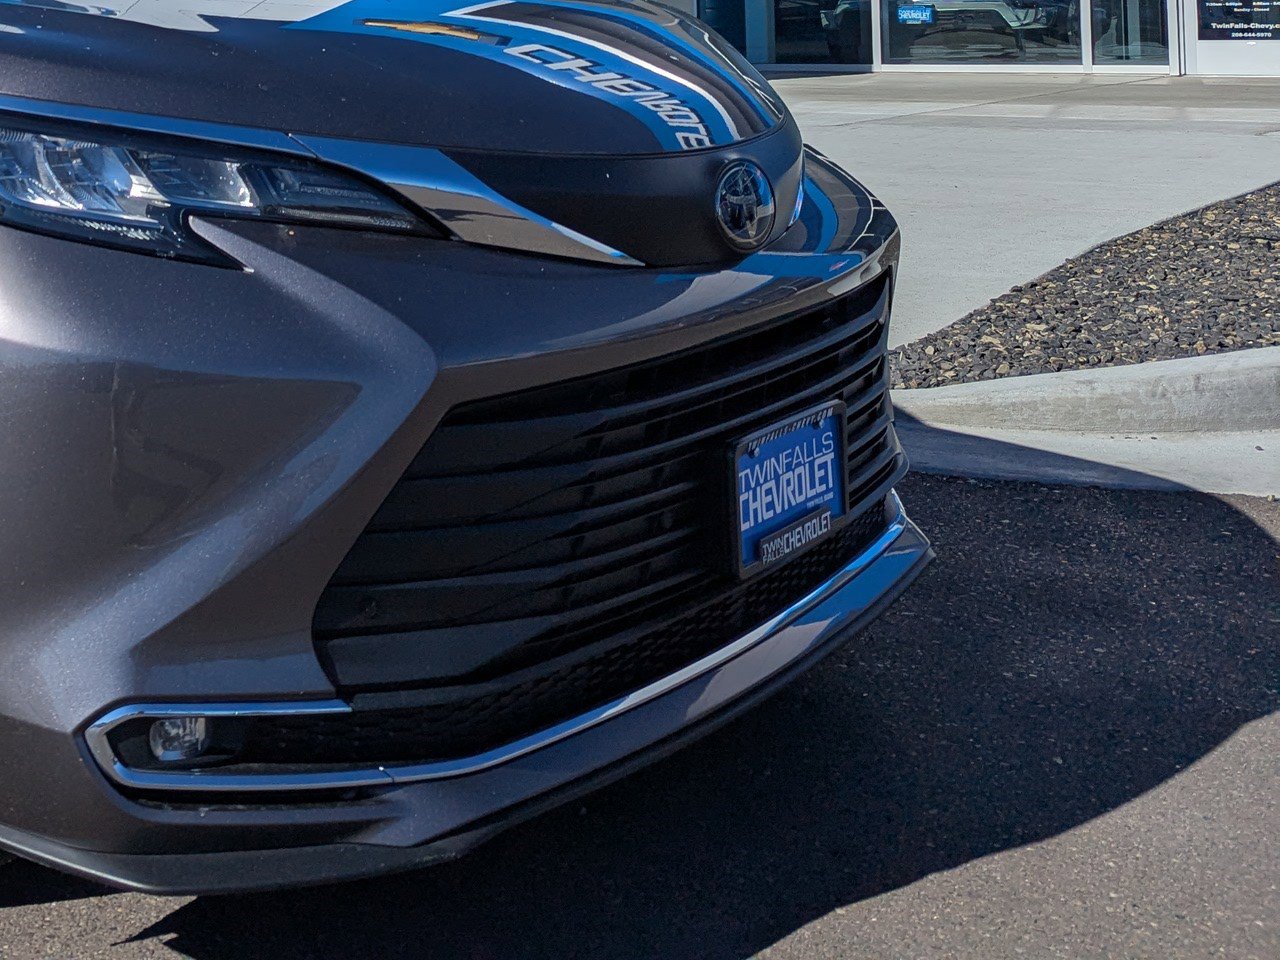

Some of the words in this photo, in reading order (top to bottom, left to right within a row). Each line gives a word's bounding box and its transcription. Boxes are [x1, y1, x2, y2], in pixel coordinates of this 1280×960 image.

[738, 431, 834, 493] TWINFALLS
[739, 451, 835, 532] CHEVROLET
[762, 535, 784, 557] TWIN
[784, 510, 832, 554] CHEVROLET
[762, 545, 785, 566] FALLS
